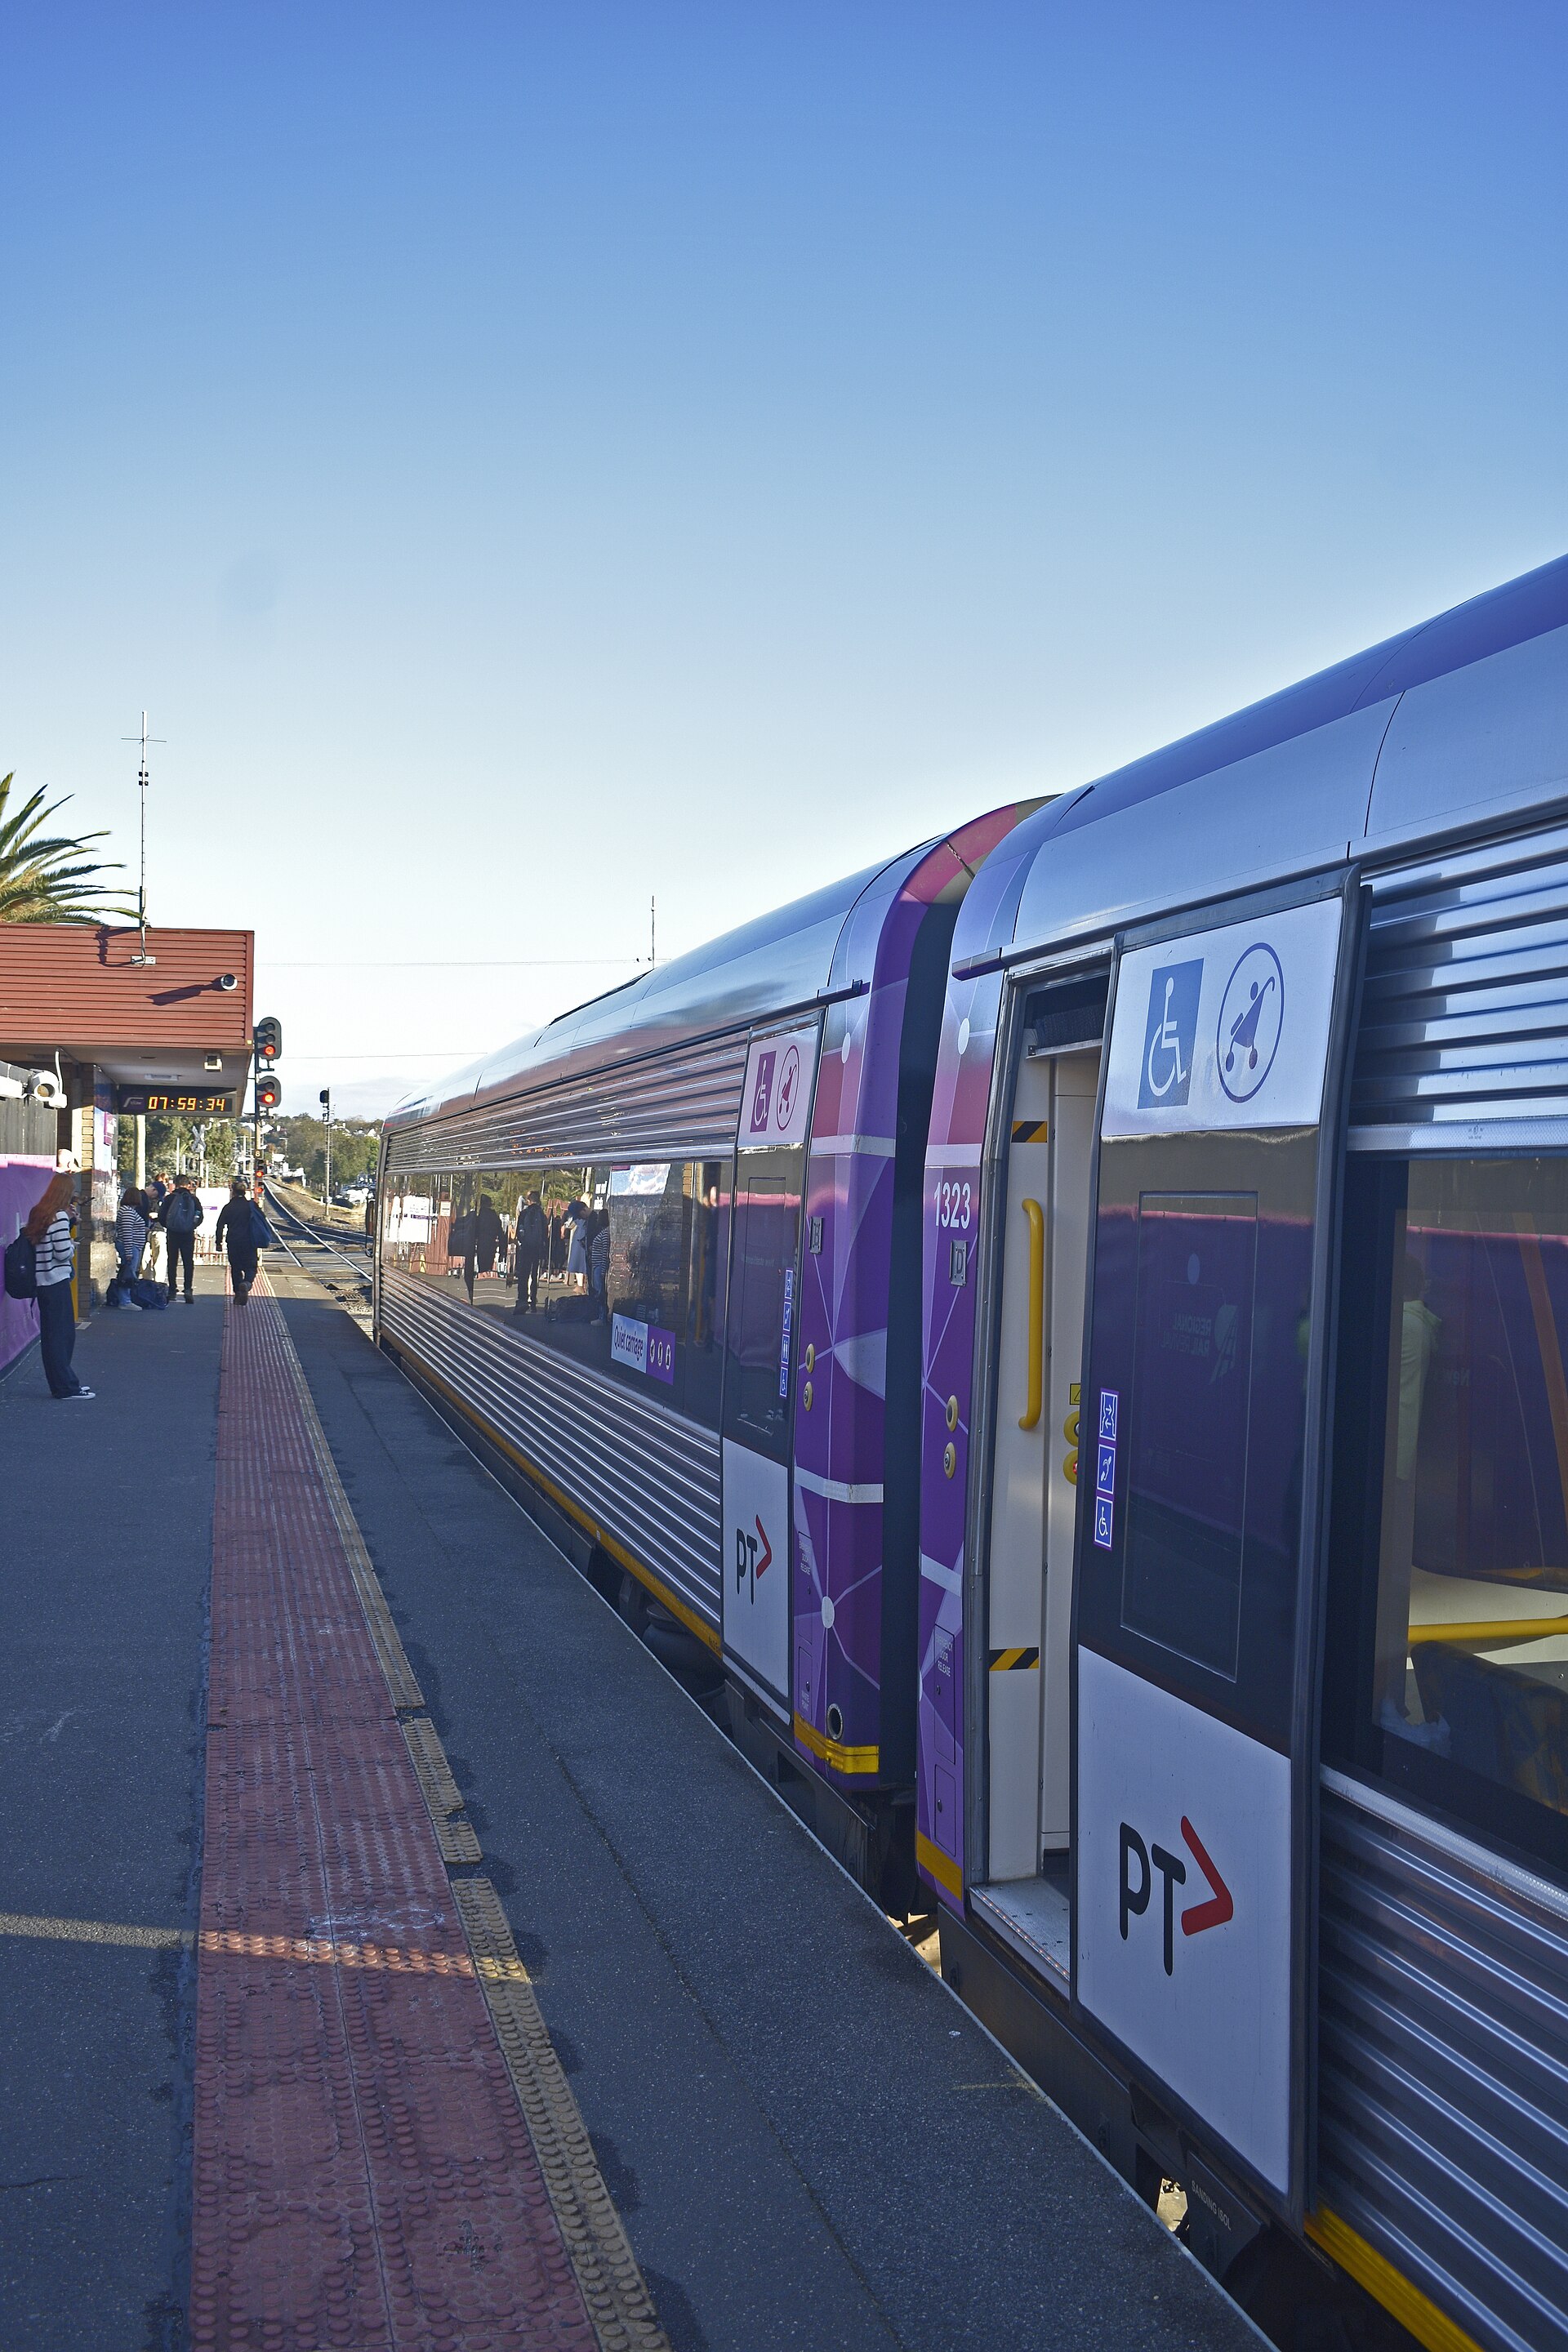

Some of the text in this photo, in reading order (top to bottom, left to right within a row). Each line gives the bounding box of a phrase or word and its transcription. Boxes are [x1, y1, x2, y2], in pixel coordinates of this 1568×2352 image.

[148, 1096, 225, 1111] 07:59:34
[933, 1182, 971, 1229] 1323
[956, 1248, 964, 1274] D
[614, 1325, 644, 1361] Quiet carriage
[938, 1659, 951, 1677] RELEASE
[1192, 2180, 1232, 2231] SANDING ISOL
